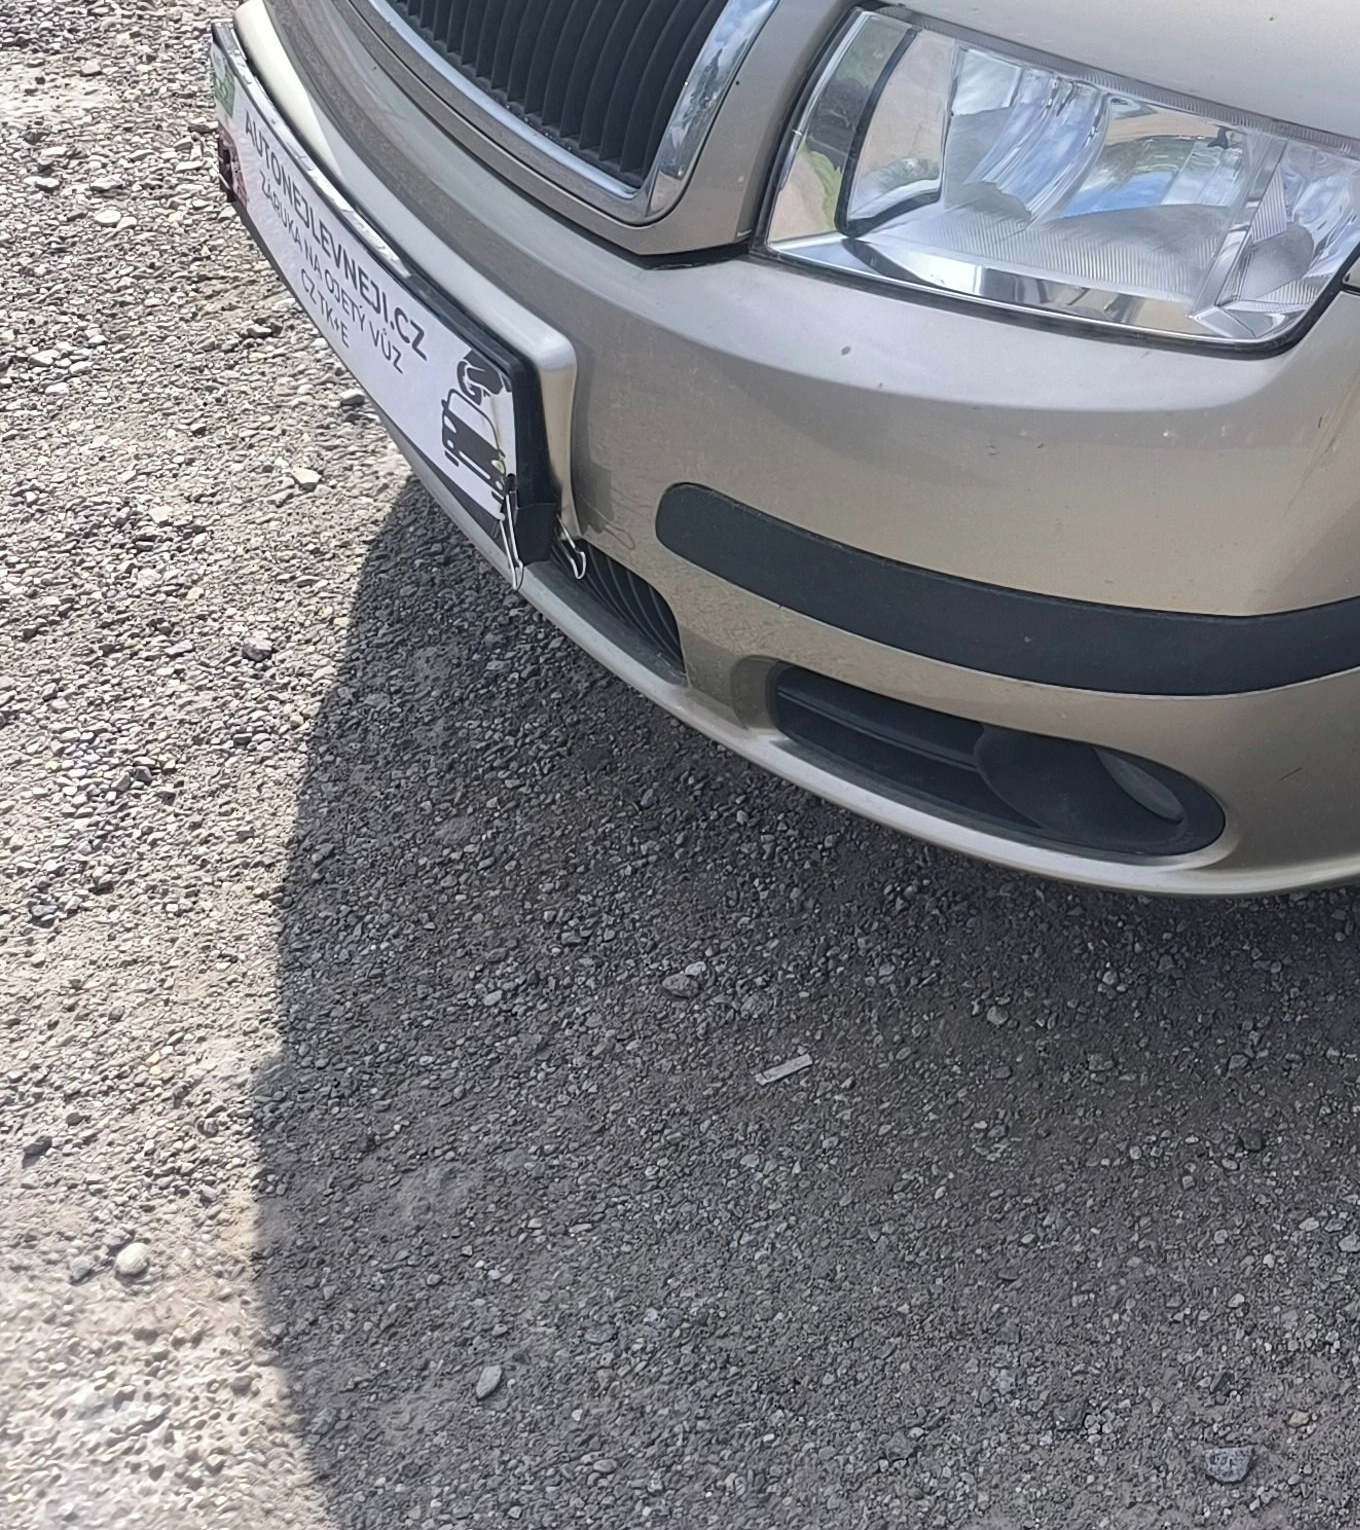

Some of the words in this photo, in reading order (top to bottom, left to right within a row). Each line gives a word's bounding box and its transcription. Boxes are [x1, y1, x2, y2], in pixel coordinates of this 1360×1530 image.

[245, 111, 428, 362] AUTONEJLEVNEJI.CZ
[259, 169, 303, 253] ZÁRUKA
[303, 239, 323, 280] NA
[325, 269, 367, 332] OJETÝ
[369, 319, 404, 375] VŮZ
[301, 269, 317, 305] CZ
